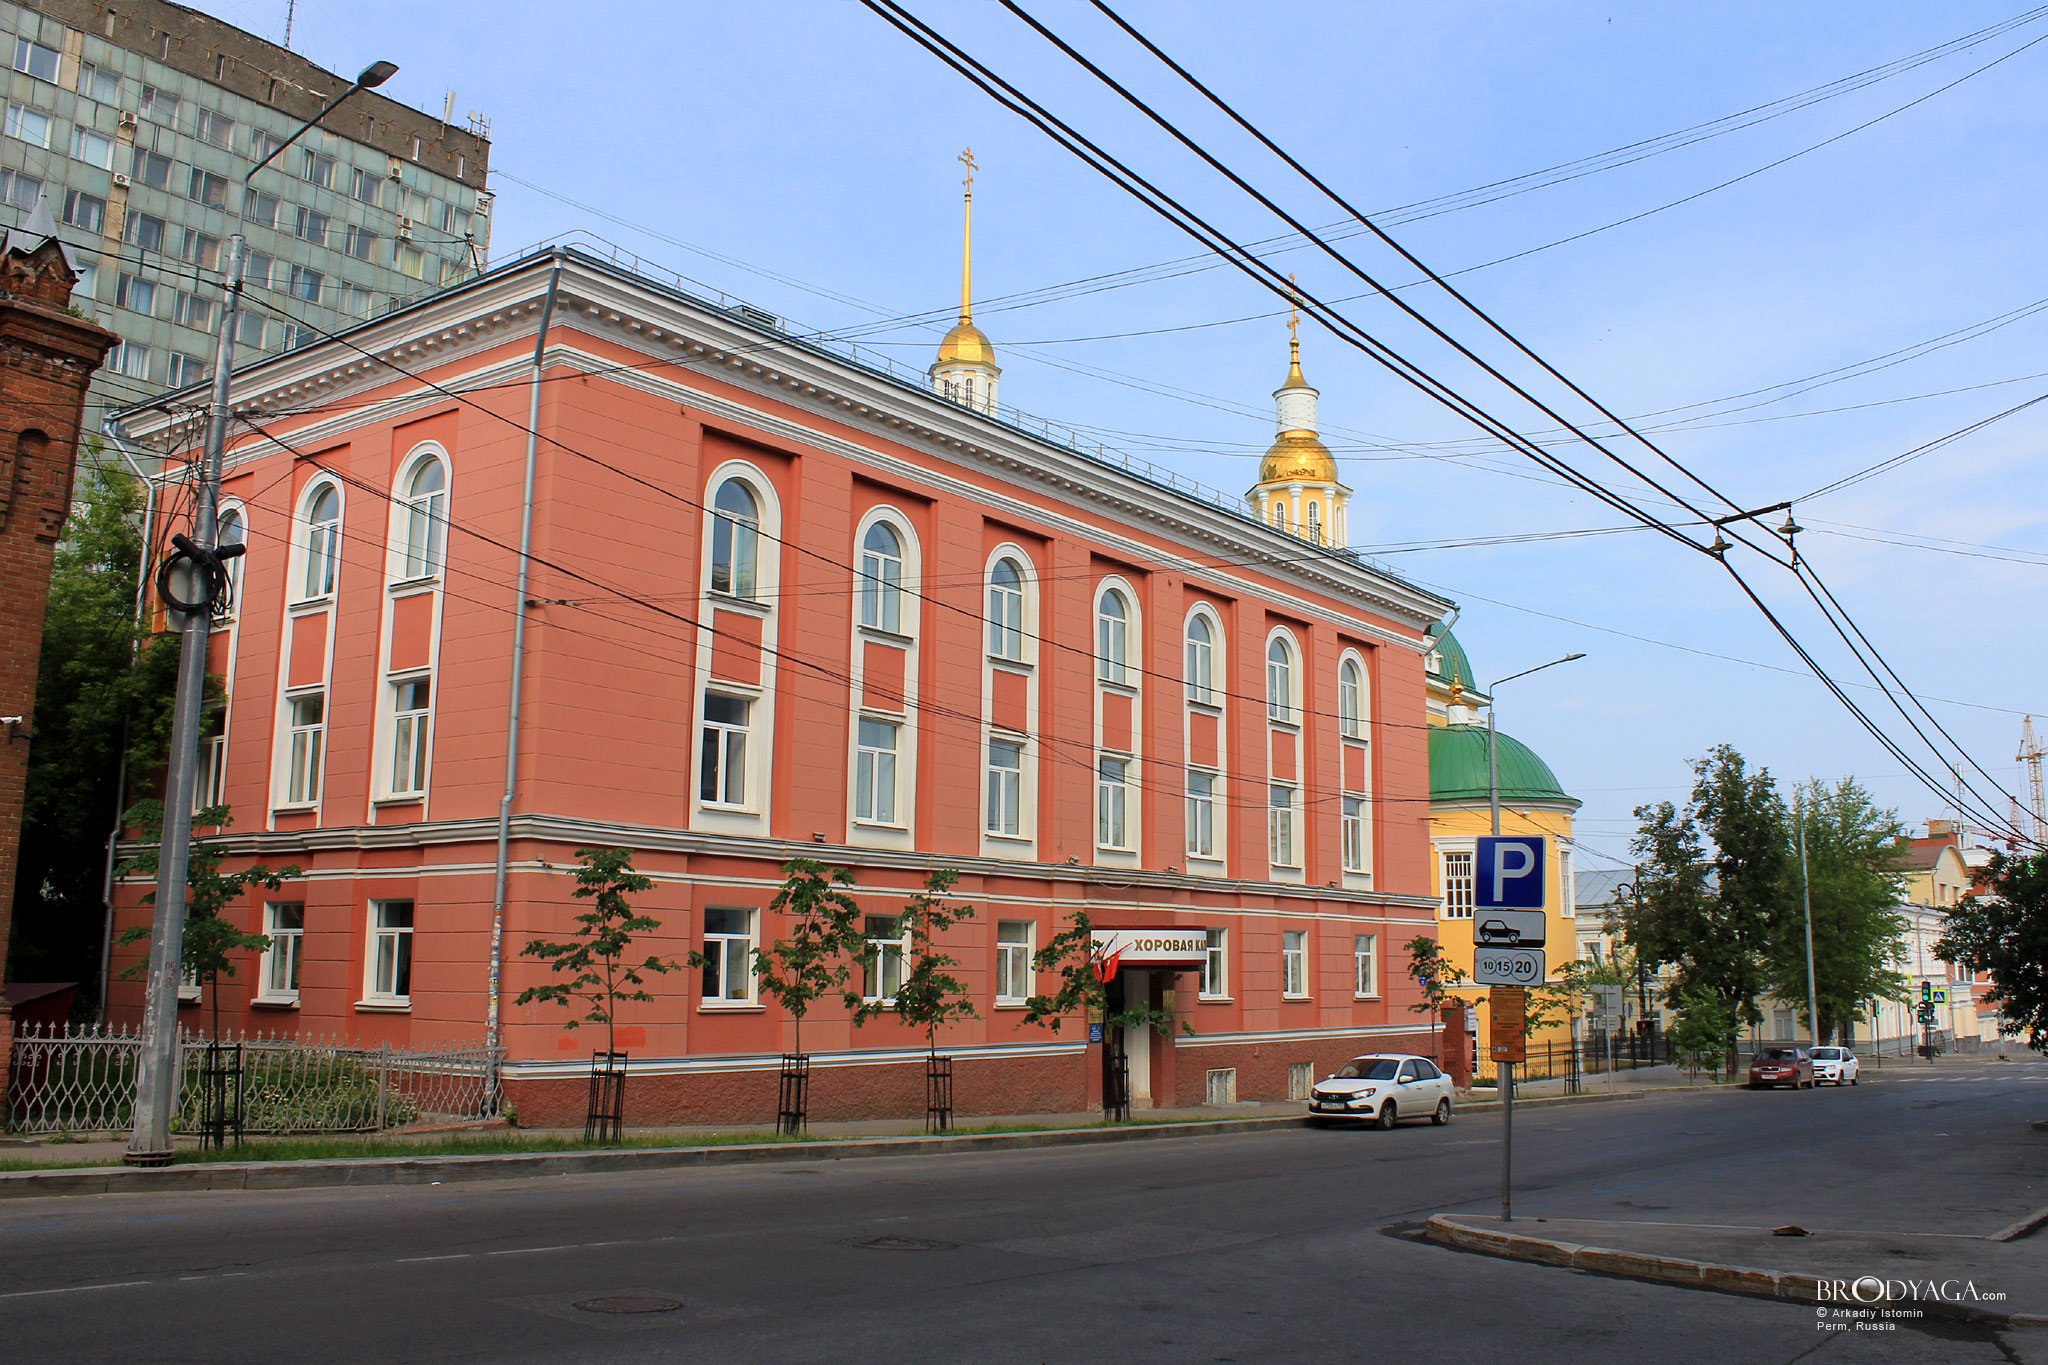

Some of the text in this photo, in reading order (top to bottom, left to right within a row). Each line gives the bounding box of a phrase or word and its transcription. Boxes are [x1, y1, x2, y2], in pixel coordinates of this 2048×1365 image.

[1493, 842, 1535, 902] P
[1134, 939, 1193, 952] ХОРОВАЯ
[1483, 961, 1531, 974] 10 15 20
